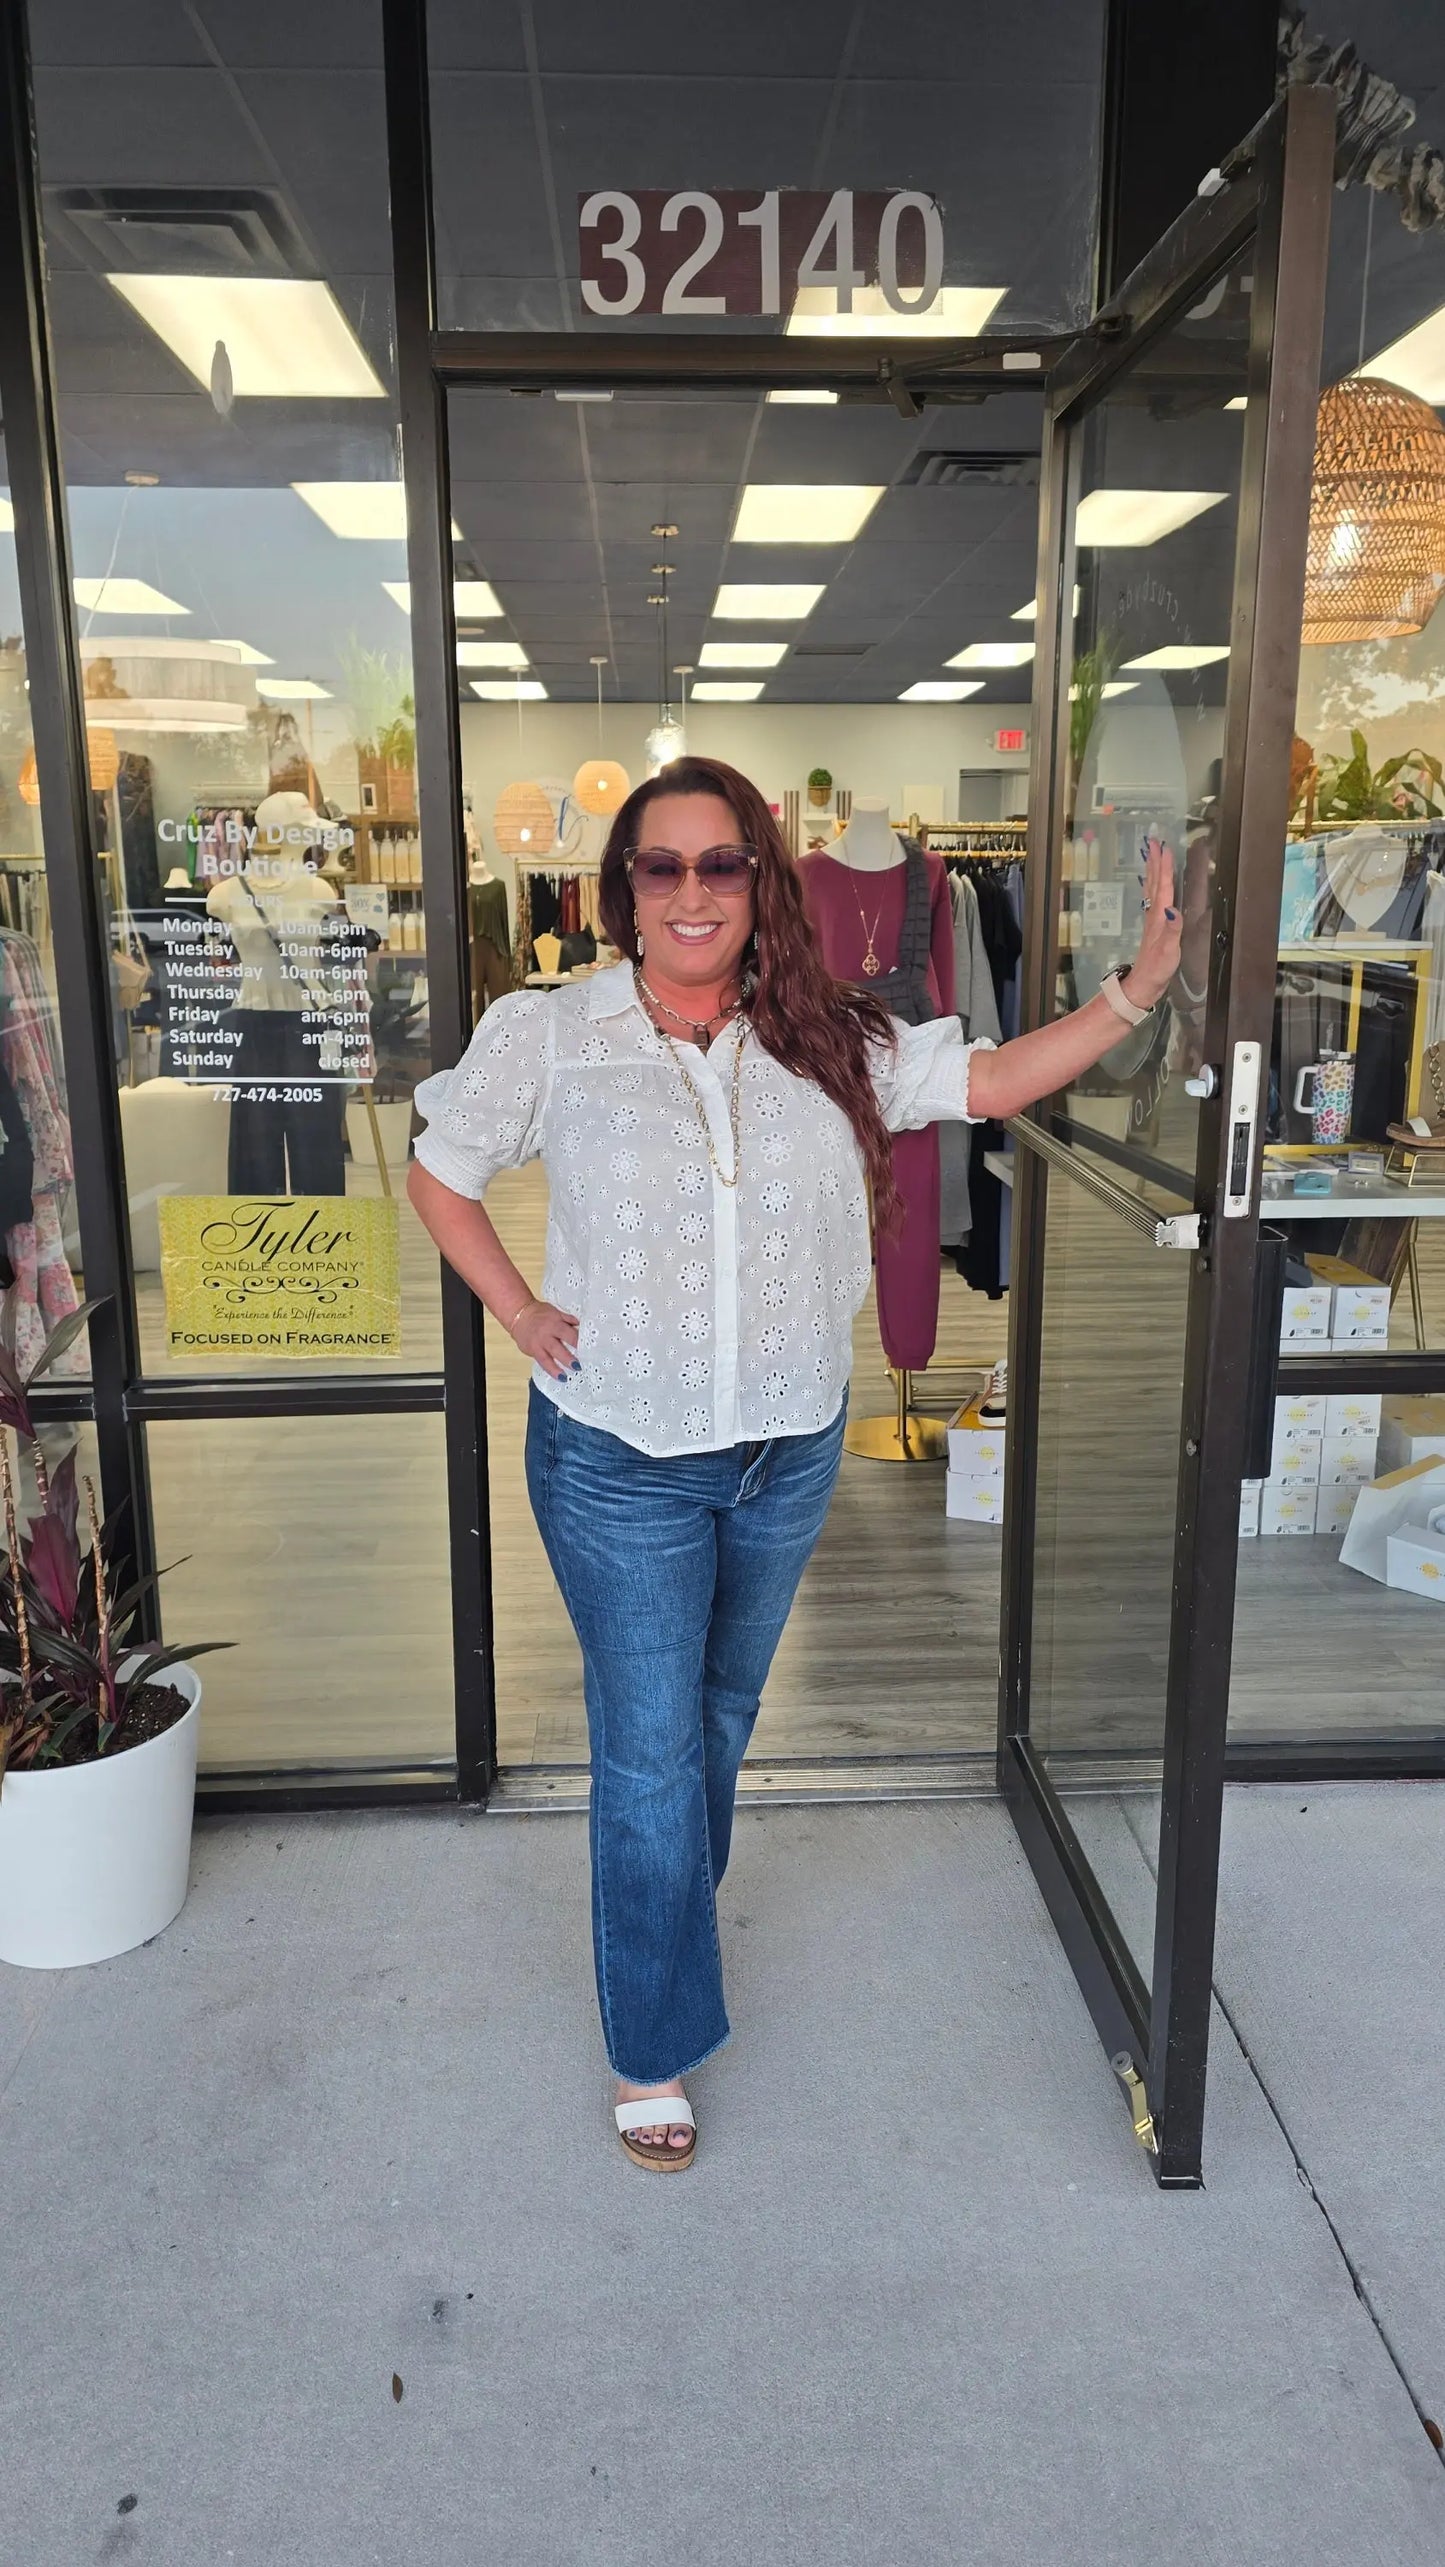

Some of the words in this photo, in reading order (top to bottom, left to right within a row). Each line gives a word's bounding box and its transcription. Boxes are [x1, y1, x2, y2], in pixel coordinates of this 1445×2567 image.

[579, 190, 944, 315] 32140
[157, 819, 217, 843] Cruz
[225, 820, 258, 849] By
[266, 823, 355, 850] Design
[203, 854, 318, 879] Boutiqe
[163, 918, 233, 937] Monday
[277, 920, 367, 939] 10am-6pm
[165, 941, 233, 960] Tuesday
[279, 942, 368, 961] 10am-6pm
[166, 962, 263, 981] Wednesday
[280, 964, 368, 983] 10am-6pm
[167, 985, 244, 1003] Thursday
[169, 1007, 220, 1025] Friday
[301, 1011, 370, 1026] am-6pm
[169, 1029, 243, 1048] Saturday
[172, 1051, 234, 1069] Sunday
[318, 1053, 370, 1069] closed
[212, 1087, 323, 1103] 727-474-2005
[200, 1201, 360, 1262] Tyler
[201, 1261, 271, 1272] CANDLE
[272, 1307, 288, 1320] the
[171, 1332, 253, 1345] FOCUSED
[257, 1333, 281, 1345] ON
